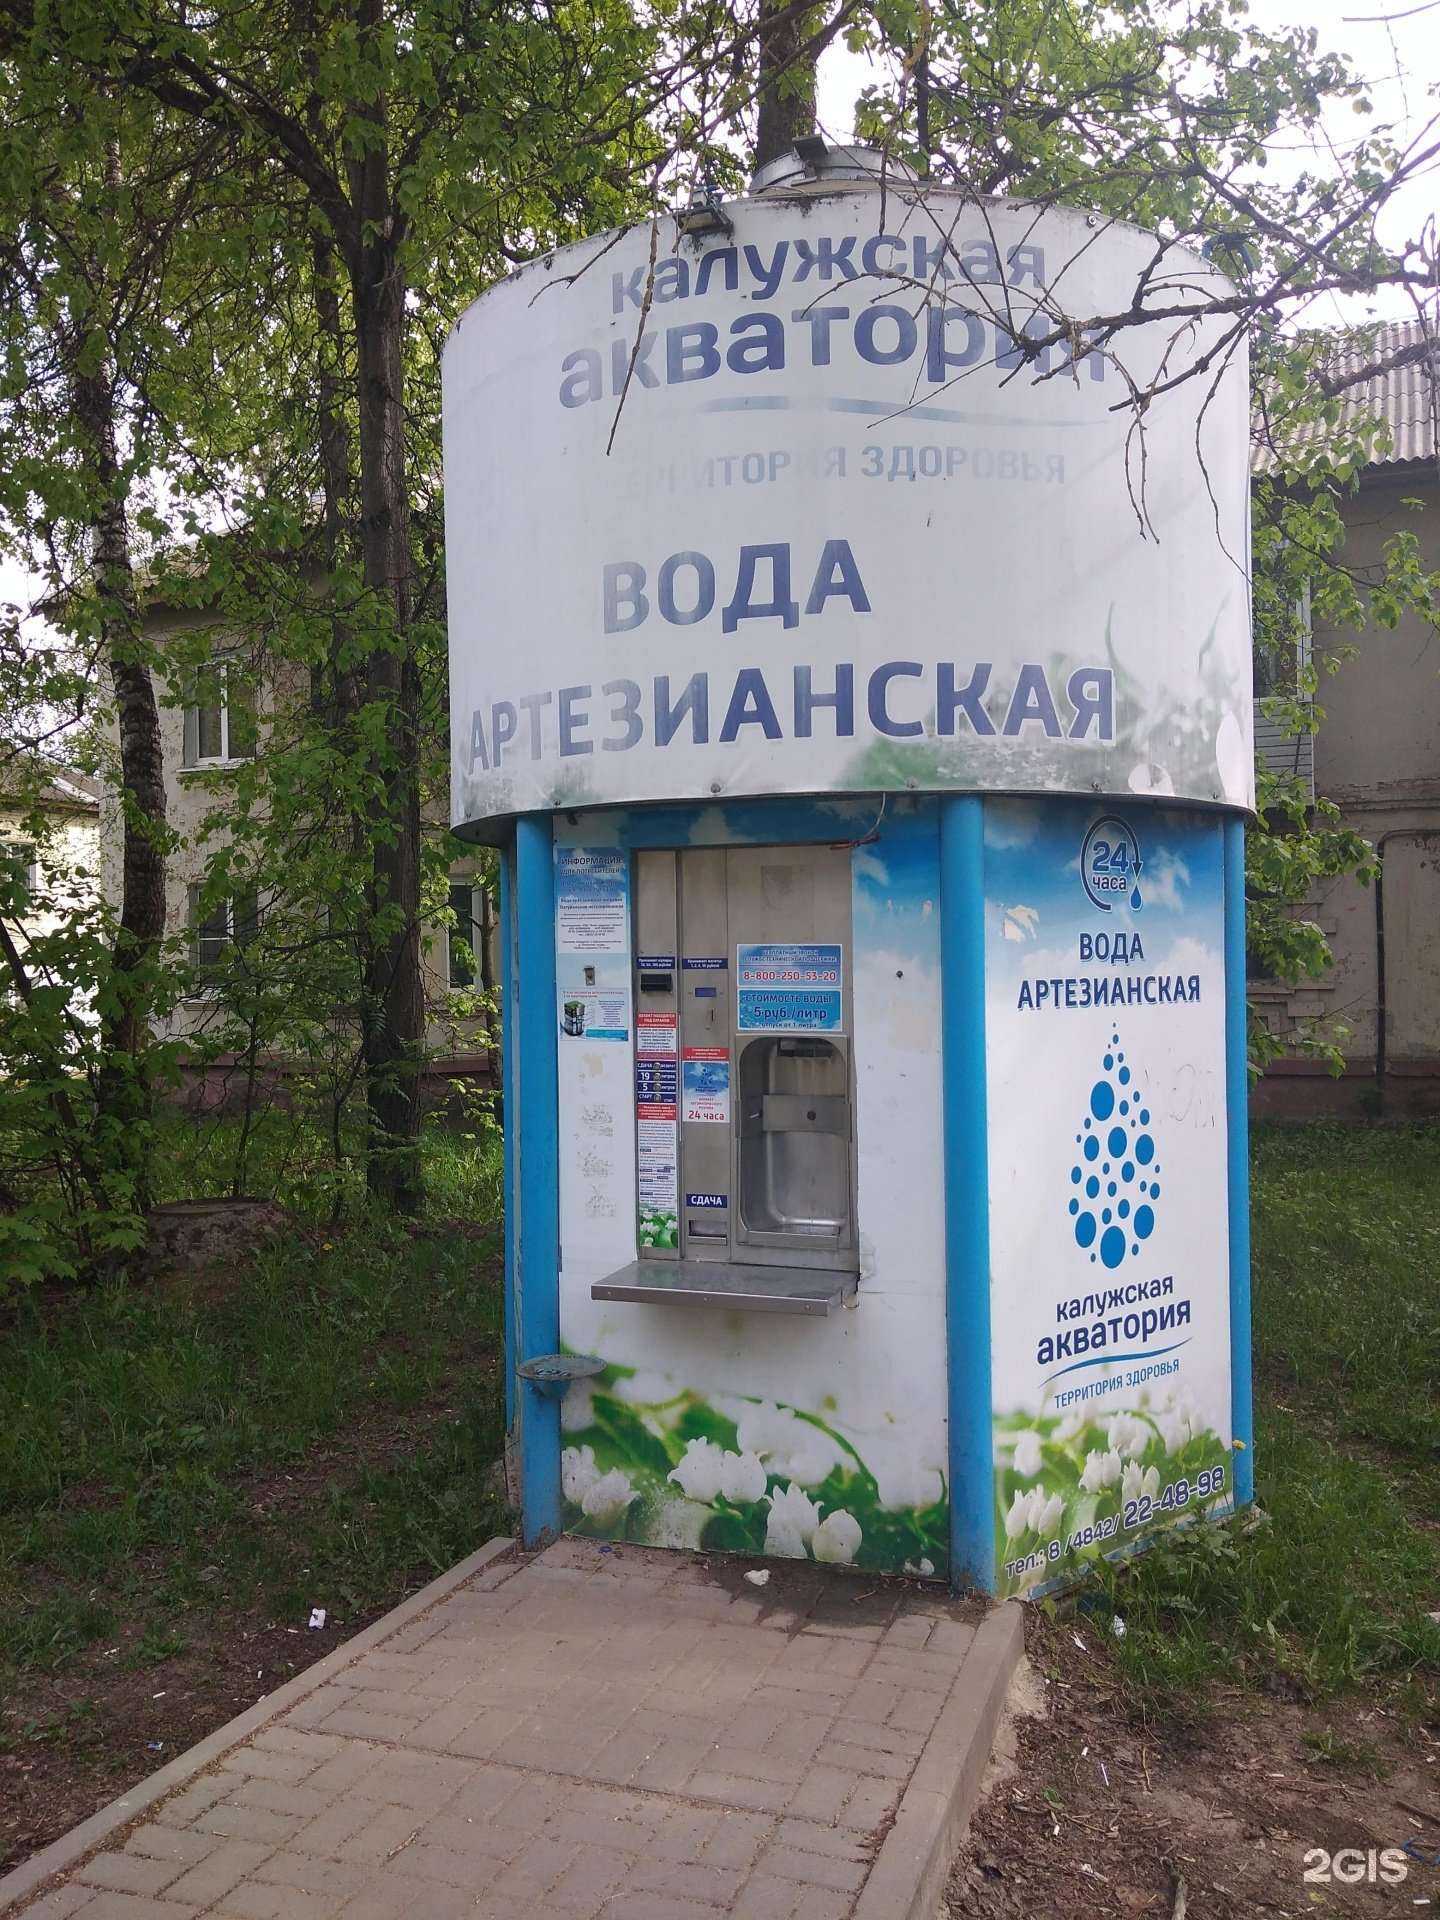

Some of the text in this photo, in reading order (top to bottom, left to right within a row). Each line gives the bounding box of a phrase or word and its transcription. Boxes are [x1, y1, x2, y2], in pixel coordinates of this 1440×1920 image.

[612, 235, 1045, 314] калужская
[603, 539, 872, 634] ВОДА
[466, 661, 1116, 776] АРТЕЗИАНСКАЯ
[1092, 841, 1129, 873] 24
[1092, 876, 1127, 890] часа
[1079, 933, 1144, 964] ВОДА
[743, 971, 836, 981] 8-800-250-53-20
[745, 994, 832, 1004] СТОИМОСТЬ ВОДЫ
[1017, 975, 1200, 1010] АРТЕЗИАНСКАЯ
[641, 1072, 650, 1081] 19
[642, 1083, 648, 1091] 5
[688, 1110, 700, 1120] 24
[691, 1195, 722, 1205] СДАЧА
[1056, 1275, 1173, 1322] калужская
[1037, 1299, 1191, 1365] акватория
[1054, 1358, 1180, 1409] ТЕРРИТОРИЯ ЗДОРОВЬЯ
[1005, 1549, 1044, 1578] тел.:
[1048, 1540, 1060, 1561] 8
[1123, 1465, 1225, 1529] 22-48-98
